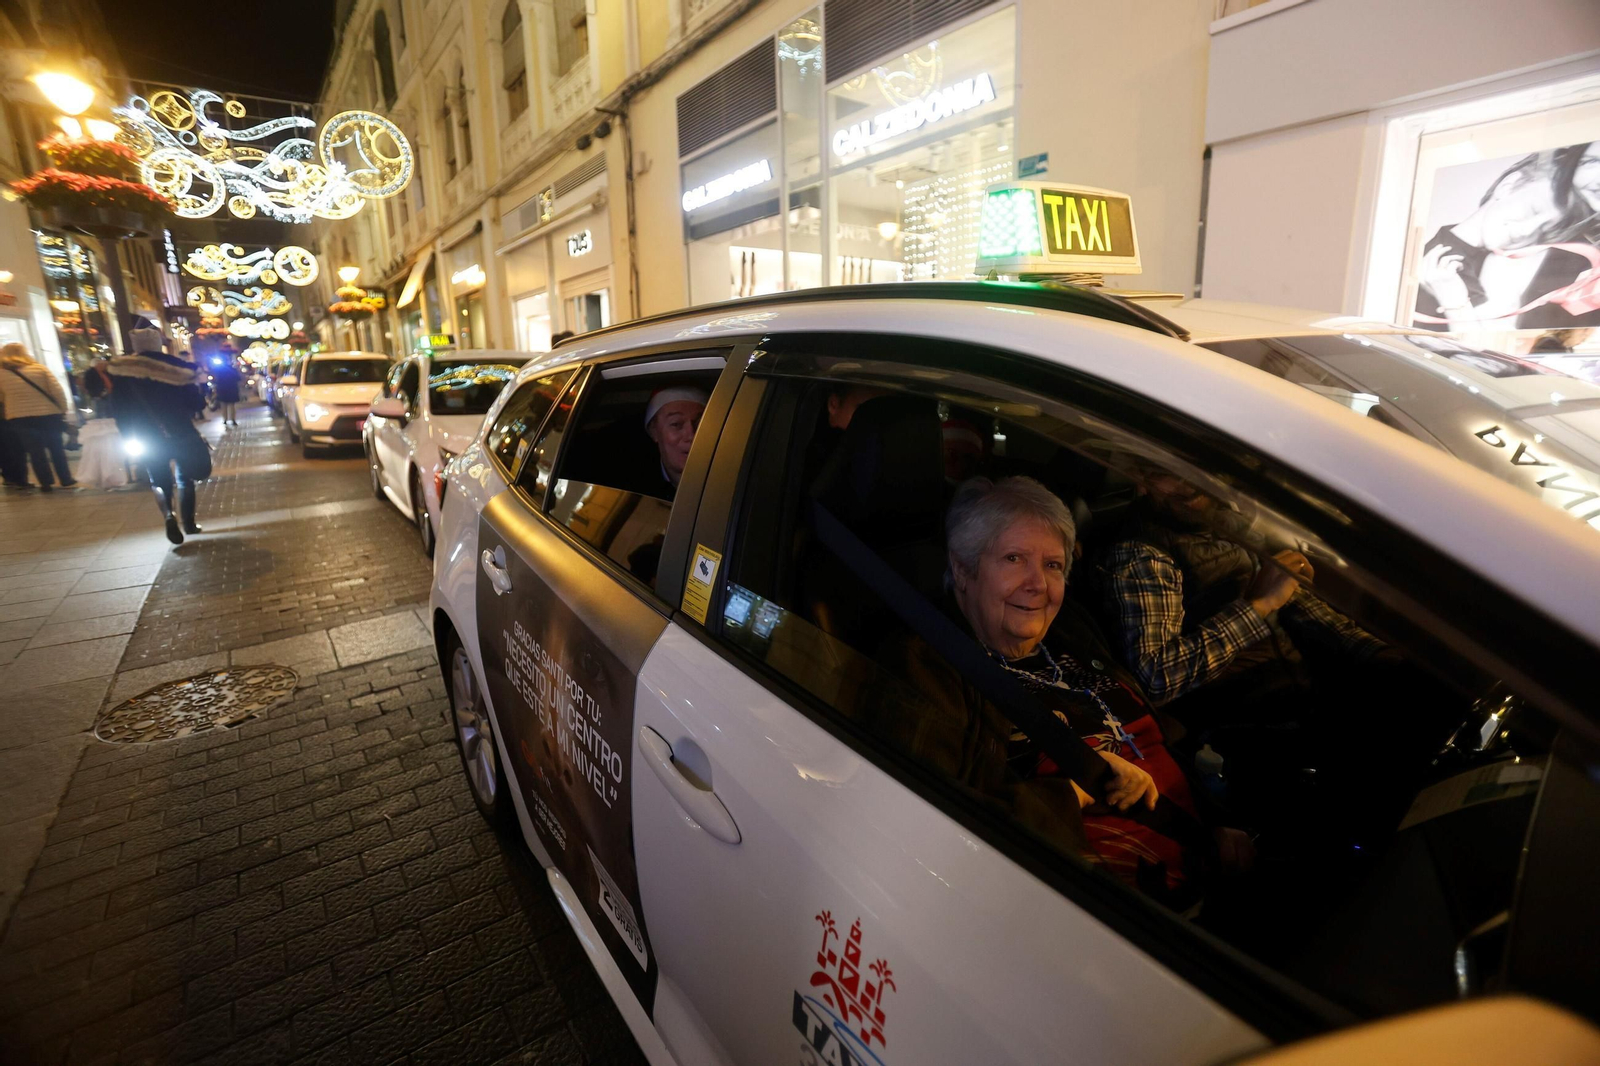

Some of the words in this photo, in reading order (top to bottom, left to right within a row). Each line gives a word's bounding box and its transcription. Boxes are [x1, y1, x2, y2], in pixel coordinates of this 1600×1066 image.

[833, 72, 996, 157] CALZEDONIA
[1043, 194, 1112, 252] TAXI
[505, 657, 521, 694] QUE
[547, 712, 555, 738] A
[556, 721, 569, 756] MI
[514, 620, 541, 661] GRACIAS
[541, 649, 563, 687] SANTI
[565, 673, 584, 709] POR
[586, 693, 602, 727] TU:
[548, 682, 564, 719] UN
[567, 703, 623, 784] CENTRO
[614, 905, 643, 953] GRATIS
